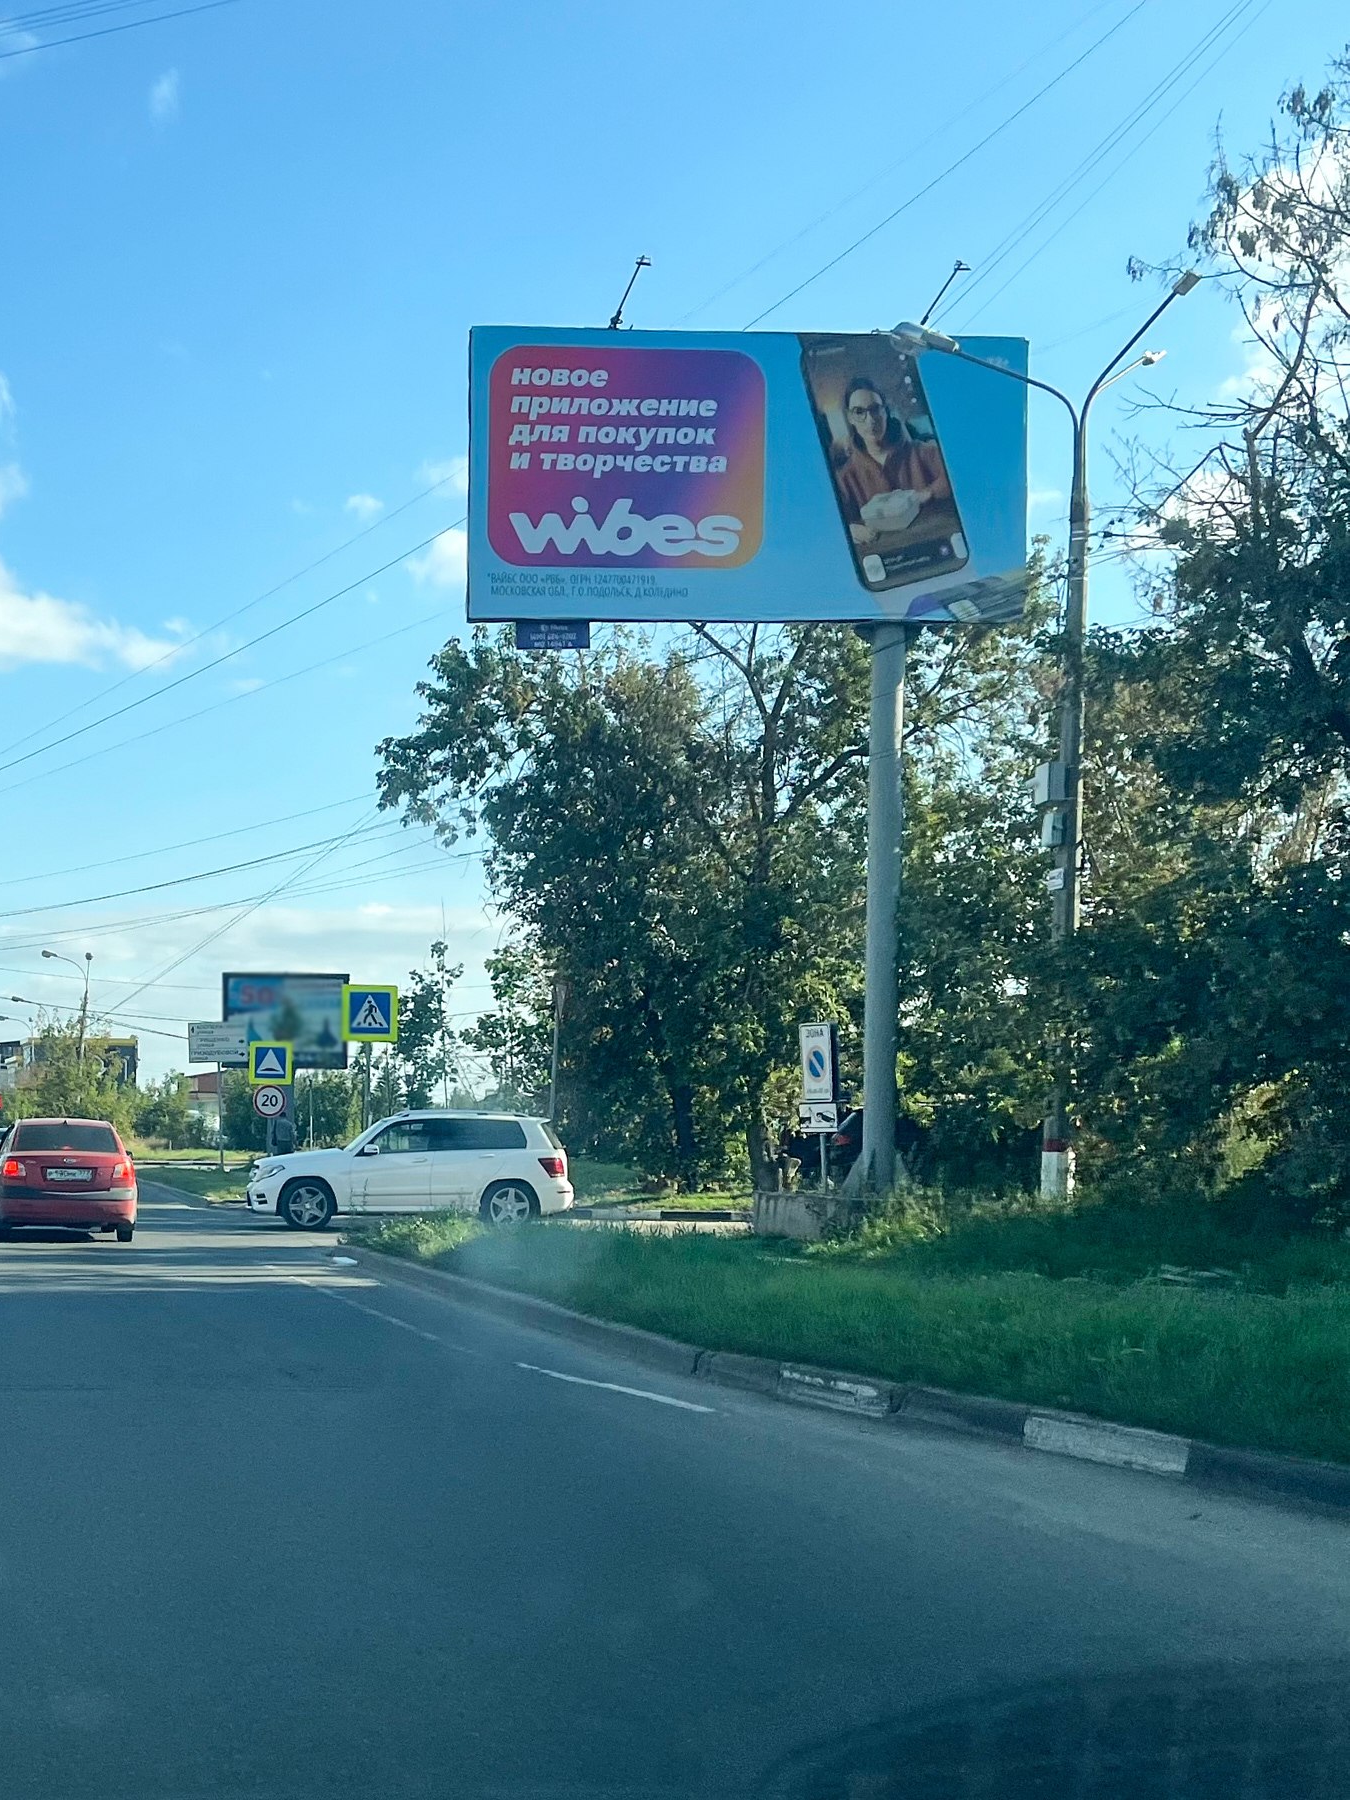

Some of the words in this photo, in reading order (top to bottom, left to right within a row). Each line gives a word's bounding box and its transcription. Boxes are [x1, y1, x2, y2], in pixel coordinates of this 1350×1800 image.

[510, 367, 609, 388] новое
[510, 395, 719, 420] приложение
[508, 424, 570, 446] для
[578, 425, 716, 452] покупок
[509, 452, 531, 470] и
[540, 453, 728, 478] творчества
[508, 496, 744, 557] wibes
[490, 585, 547, 597] МОСКОВСКАЯ
[805, 1028, 825, 1038] ЗОНА
[261, 1094, 279, 1107] 20
